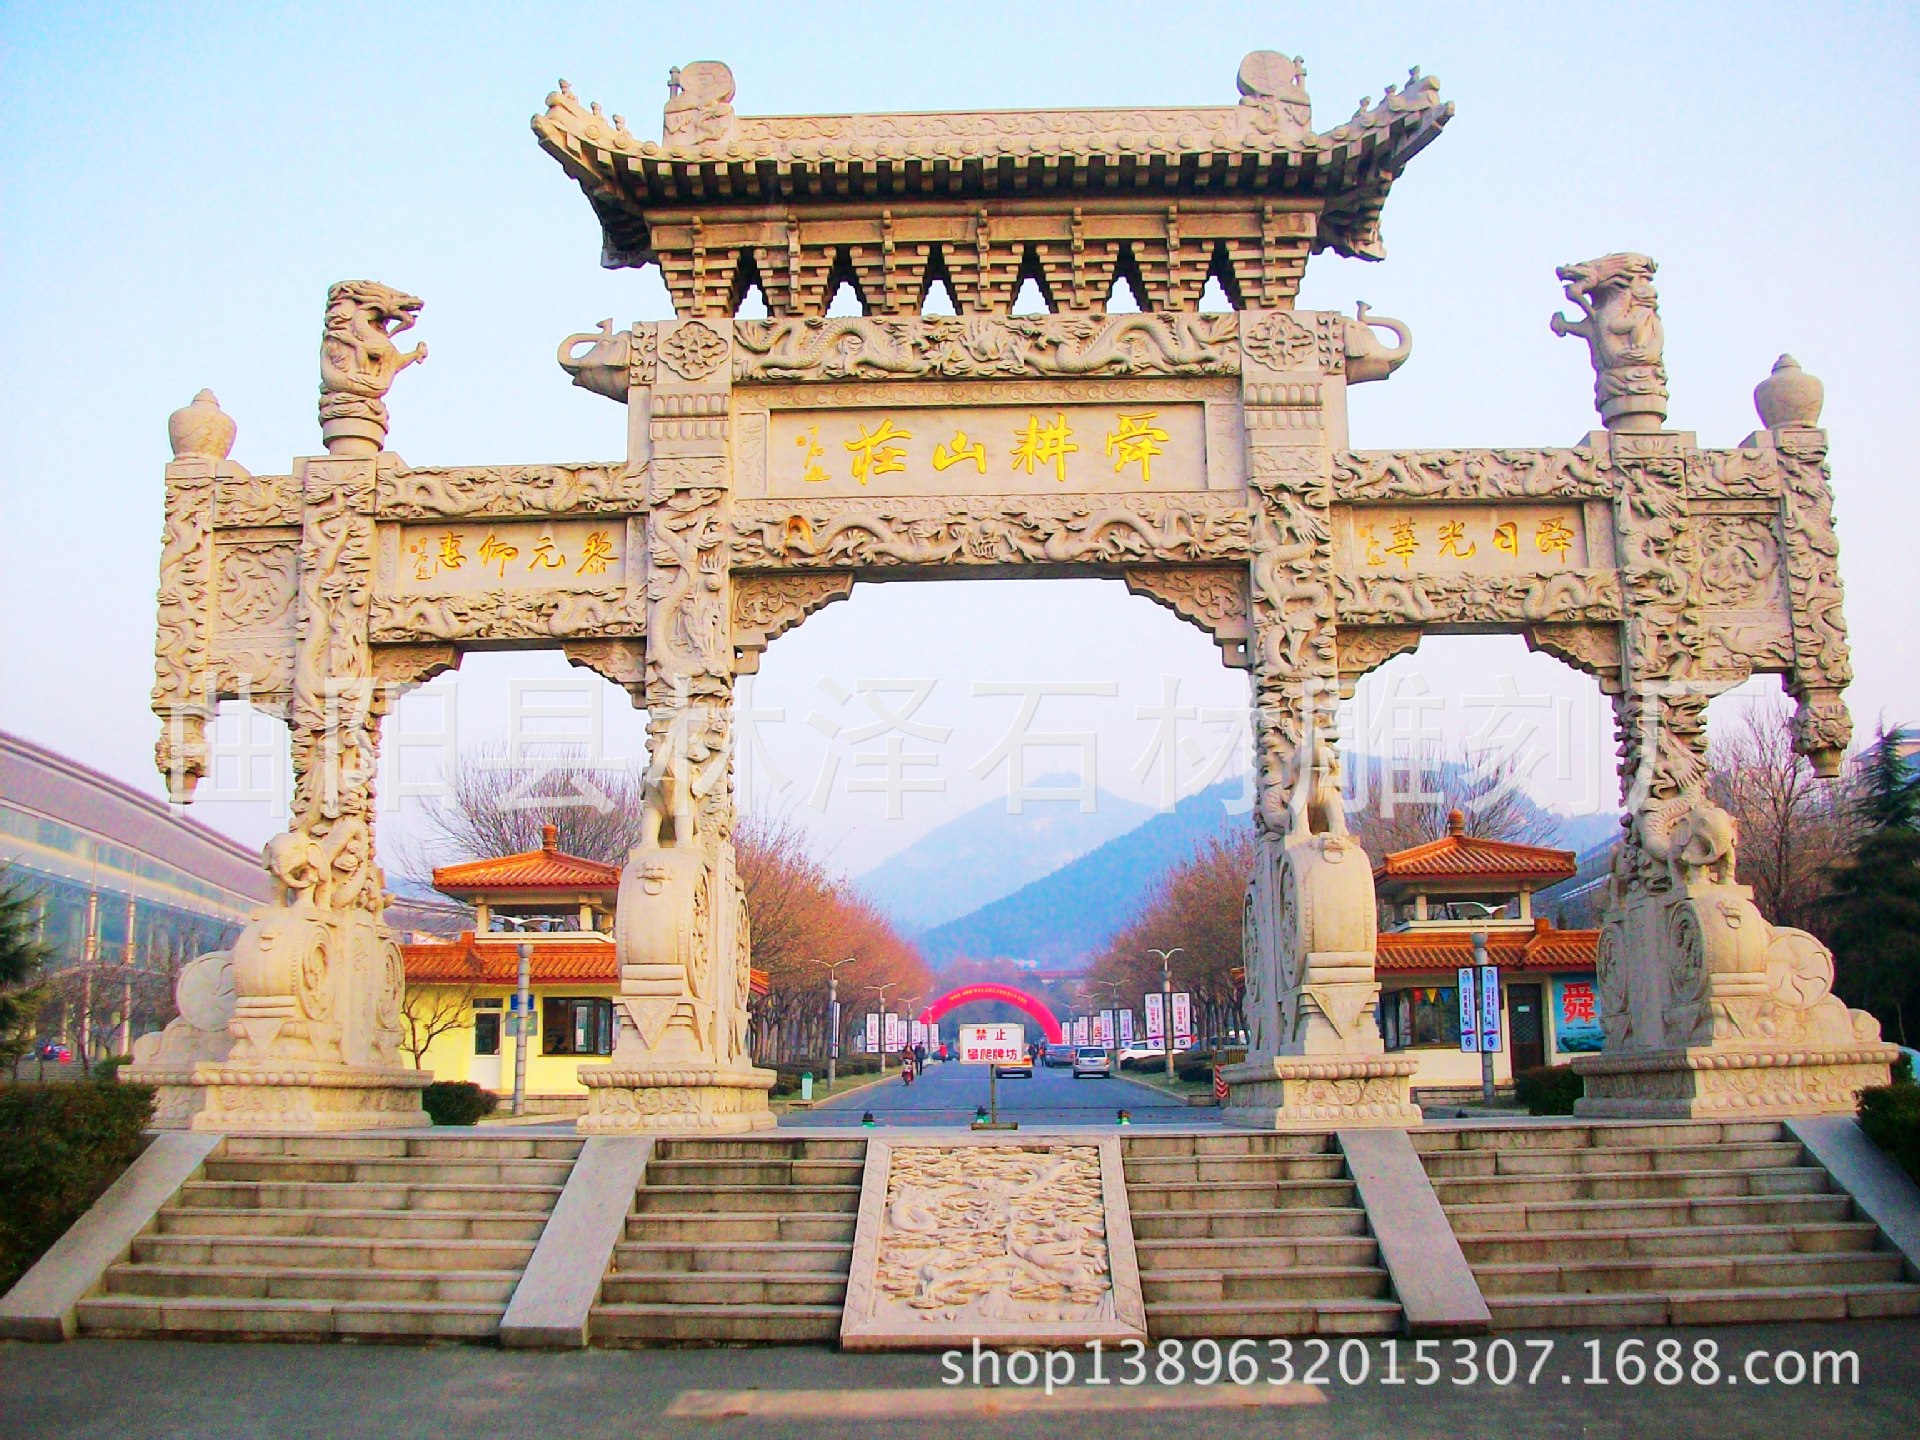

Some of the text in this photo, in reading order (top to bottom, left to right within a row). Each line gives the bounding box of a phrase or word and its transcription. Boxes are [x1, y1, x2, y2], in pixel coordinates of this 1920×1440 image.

[1562, 982, 1597, 1024] 舜
[976, 1028, 1007, 1041] 禁止
[968, 1048, 1017, 1060] 攀爬牌坊
